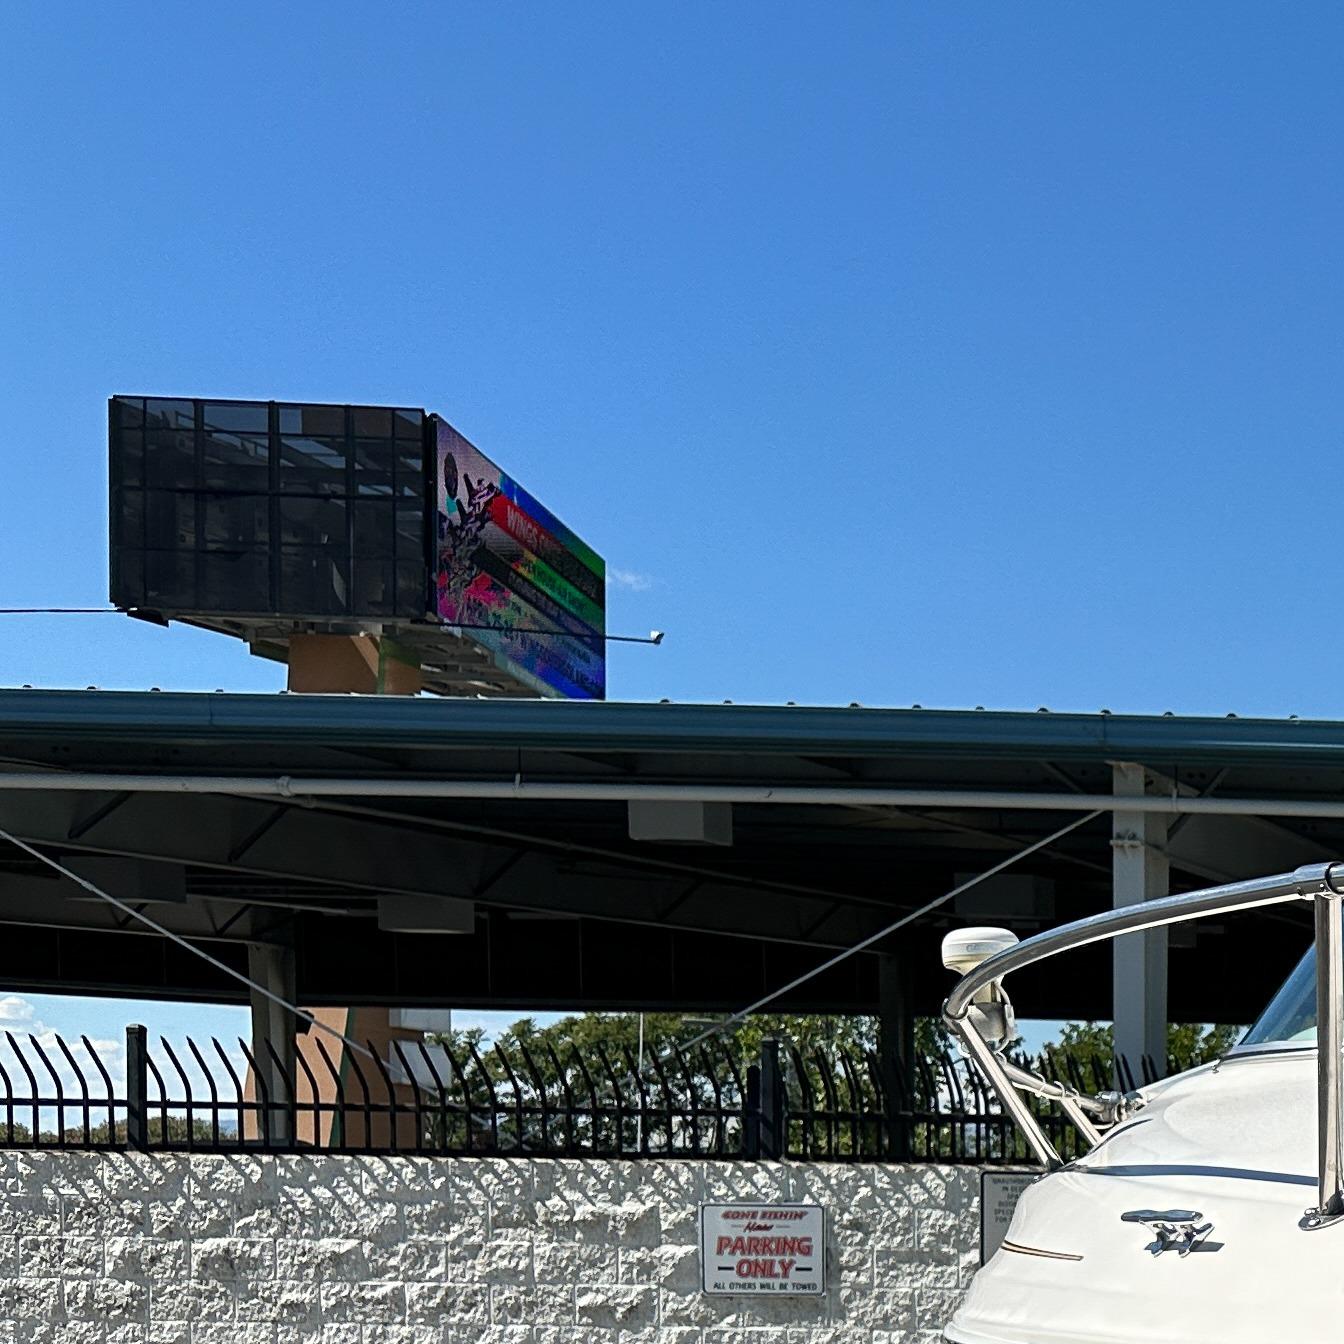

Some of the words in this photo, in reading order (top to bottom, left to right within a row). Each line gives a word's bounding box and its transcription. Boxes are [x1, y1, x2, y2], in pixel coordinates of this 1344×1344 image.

[507, 504, 537, 551] WINGS
[716, 1236, 813, 1256] PARKING
[735, 1258, 796, 1279] ONLY
[713, 1282, 725, 1290] ALL
[729, 1282, 757, 1290] OTHERS
[760, 1282, 776, 1290] WILL
[780, 1282, 788, 1290] BE
[792, 1282, 817, 1291] TOWED
